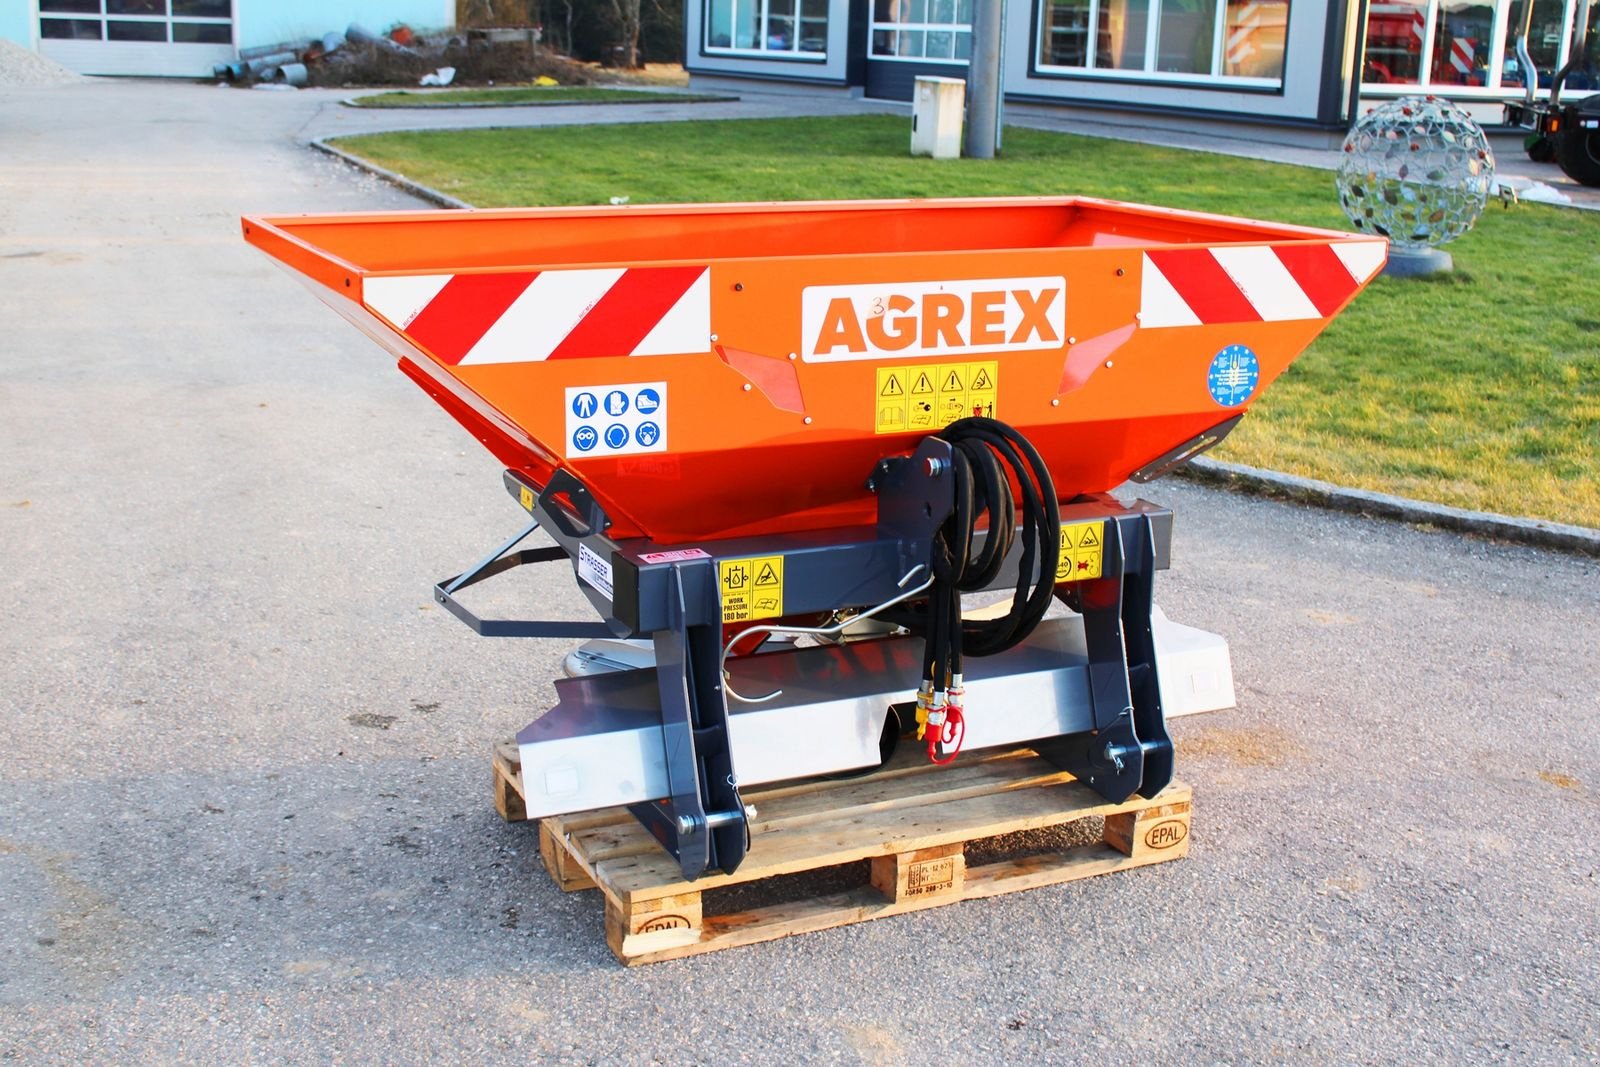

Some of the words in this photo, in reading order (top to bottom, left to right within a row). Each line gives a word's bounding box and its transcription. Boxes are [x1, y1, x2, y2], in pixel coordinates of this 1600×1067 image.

[872, 296, 885, 315] 3
[813, 288, 1060, 355] AGREX
[723, 603, 748, 612] PRESSURE
[729, 597, 744, 605] WORK
[724, 612, 735, 621] 180
[1151, 825, 1181, 845] EPAL
